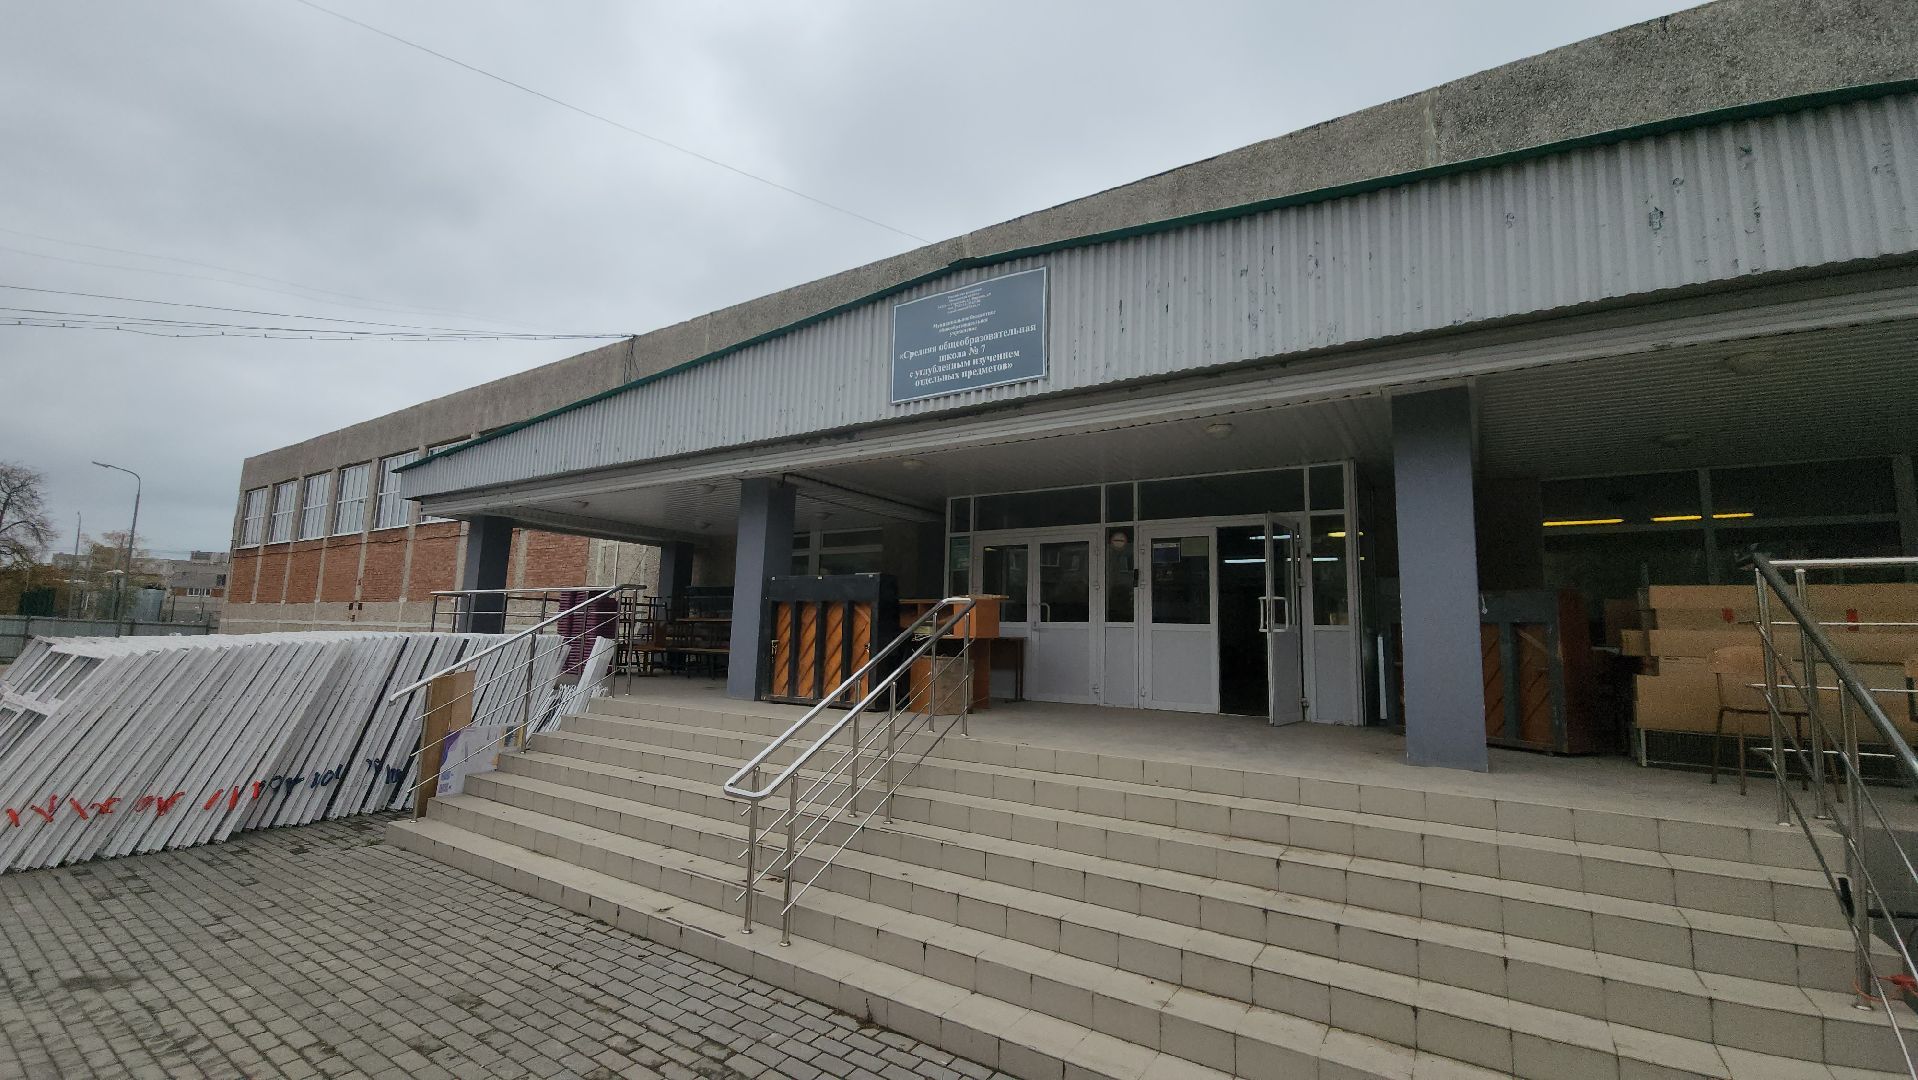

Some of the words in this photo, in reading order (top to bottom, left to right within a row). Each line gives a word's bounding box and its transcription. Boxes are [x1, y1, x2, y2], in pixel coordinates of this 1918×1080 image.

[899, 345, 936, 360] «Средняя
[939, 324, 1036, 351] общеобразовательная
[939, 350, 967, 362] школа
[972, 350, 1020, 366] изучением
[915, 372, 960, 386] отдельных
[961, 362, 1013, 379] предметов»
